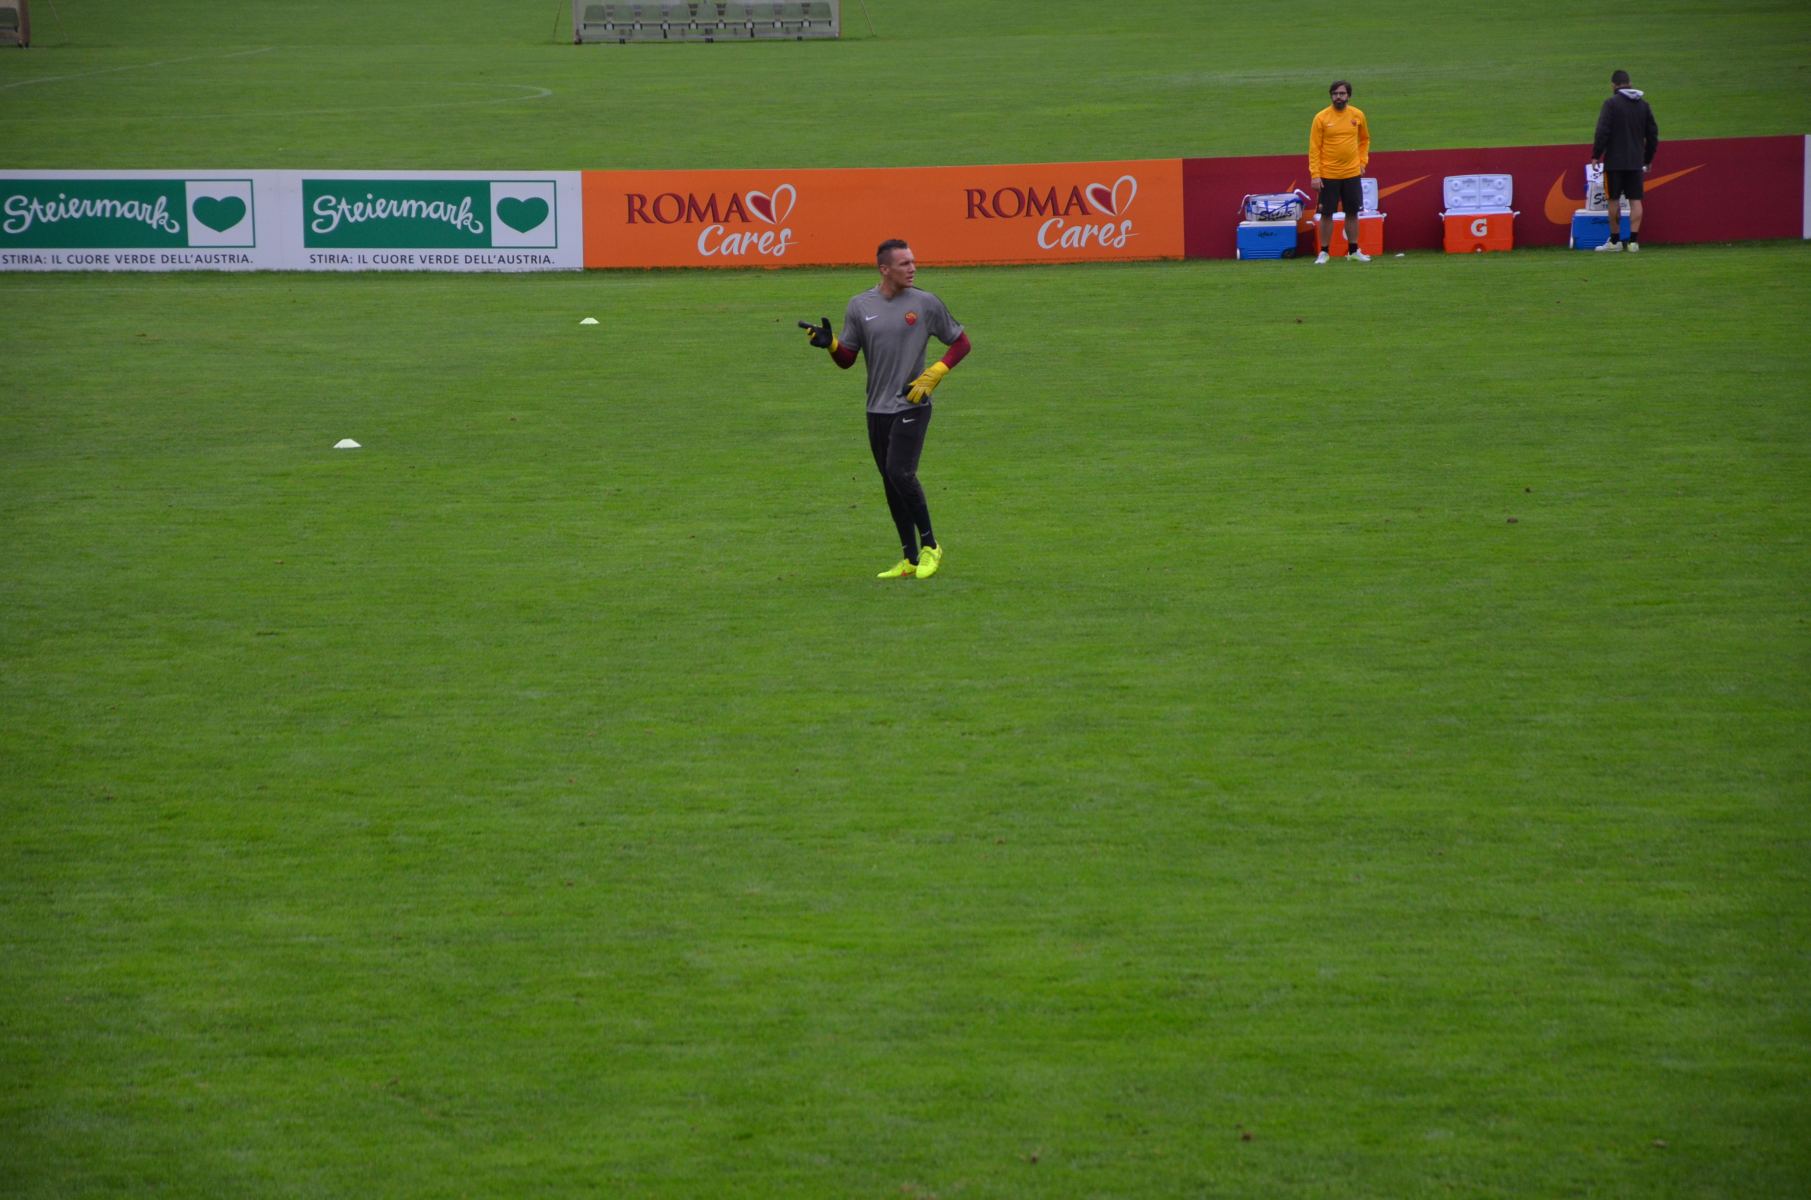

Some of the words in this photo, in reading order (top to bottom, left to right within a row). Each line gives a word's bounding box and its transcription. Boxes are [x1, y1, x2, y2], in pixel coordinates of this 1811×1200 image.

[3, 193, 181, 234] Steiermark
[312, 193, 484, 234] Steiermark
[624, 192, 752, 224] ROMA
[963, 185, 1092, 219] ROMA
[697, 224, 800, 256] Cares
[1037, 217, 1139, 249] Cares
[1471, 218, 1488, 237] G
[2, 253, 47, 265] STIRIA:
[51, 253, 63, 265] IL
[67, 253, 110, 265] CUORE
[116, 253, 156, 265] VERDE
[310, 253, 353, 265] STIRIA:
[358, 253, 369, 265] IL
[373, 253, 415, 265] CUORE
[420, 253, 459, 265] VERDE
